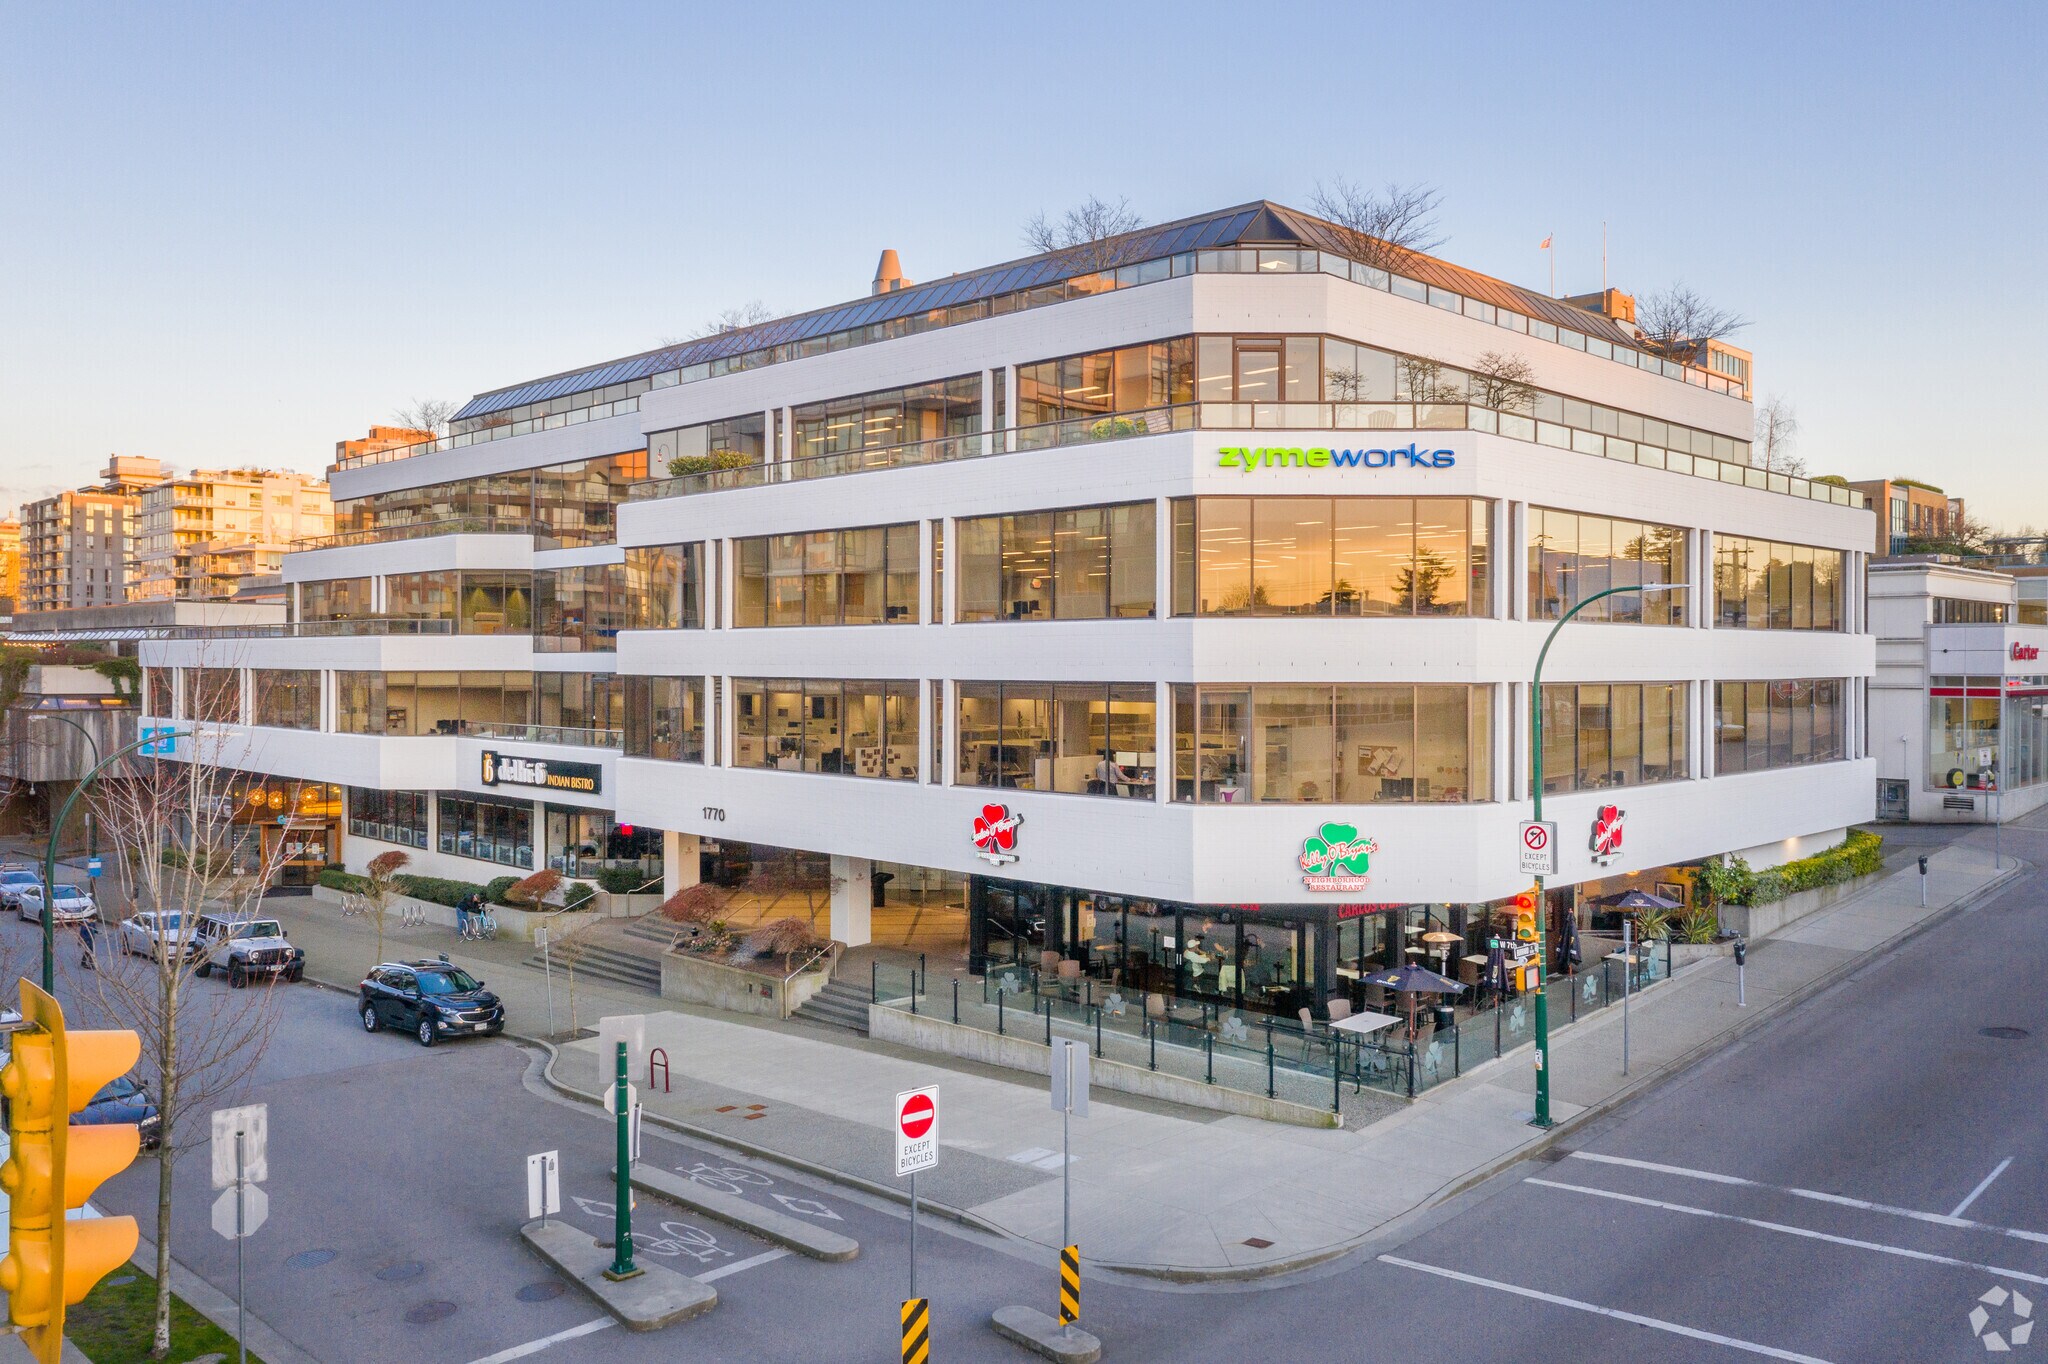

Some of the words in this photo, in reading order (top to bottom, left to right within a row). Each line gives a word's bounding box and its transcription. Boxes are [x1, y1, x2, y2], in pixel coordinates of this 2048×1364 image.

[1218, 443, 1456, 472] zymeworks
[2012, 641, 2040, 661] Carter
[547, 774, 571, 788] INDIAN
[571, 777, 594, 791] BISTRO
[702, 806, 726, 822] 1770
[1299, 851, 1328, 870] Kelly
[1524, 853, 1547, 861] EXCEPT
[1522, 862, 1550, 871] BICYCLES
[1499, 941, 1506, 949] W
[904, 1140, 931, 1156] EXCEPT
[901, 1151, 933, 1168] BICYCLES
